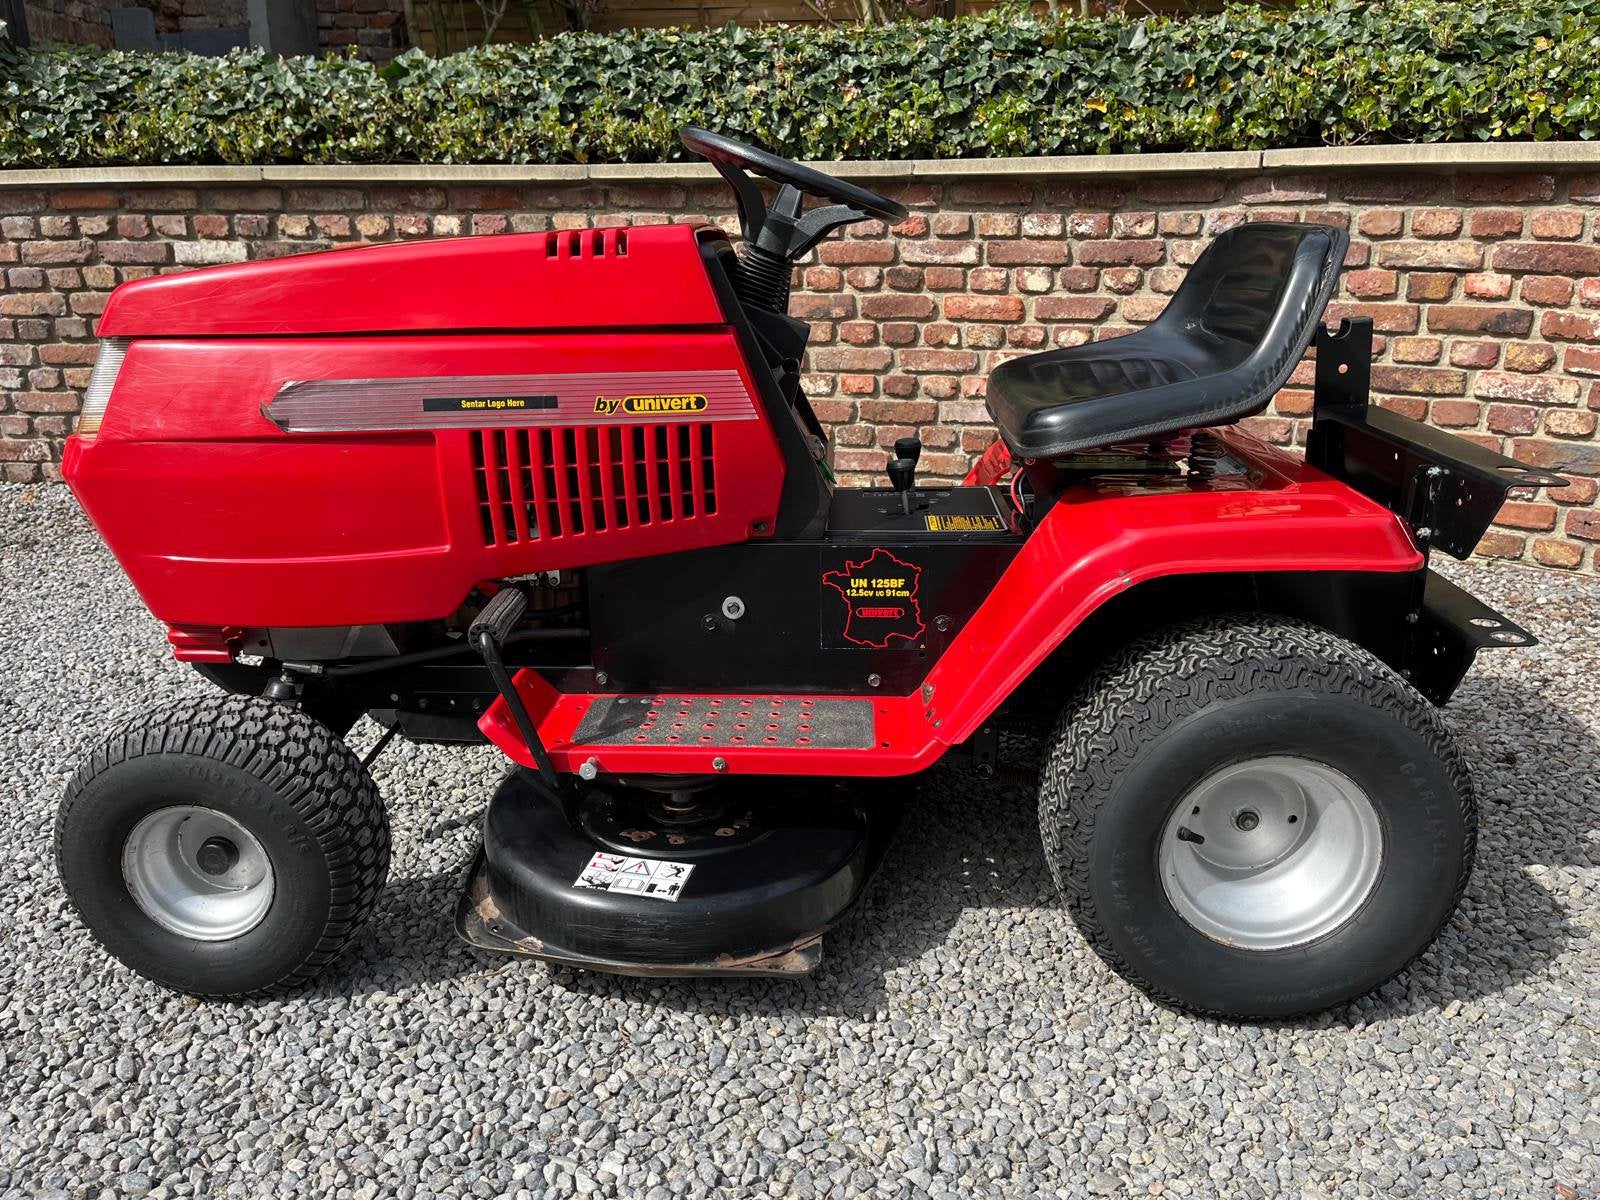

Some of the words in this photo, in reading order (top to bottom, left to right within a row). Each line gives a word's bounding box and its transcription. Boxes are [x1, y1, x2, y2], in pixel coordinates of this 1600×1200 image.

[461, 400, 485, 408] Sentar
[487, 399, 505, 409] Logo
[507, 398, 525, 407] Here
[594, 396, 621, 415] by
[633, 395, 697, 411] univert
[850, 578, 868, 588] UN
[870, 578, 905, 588] 125BF
[846, 588, 874, 597] 12.5cv
[885, 588, 910, 597] 91cm
